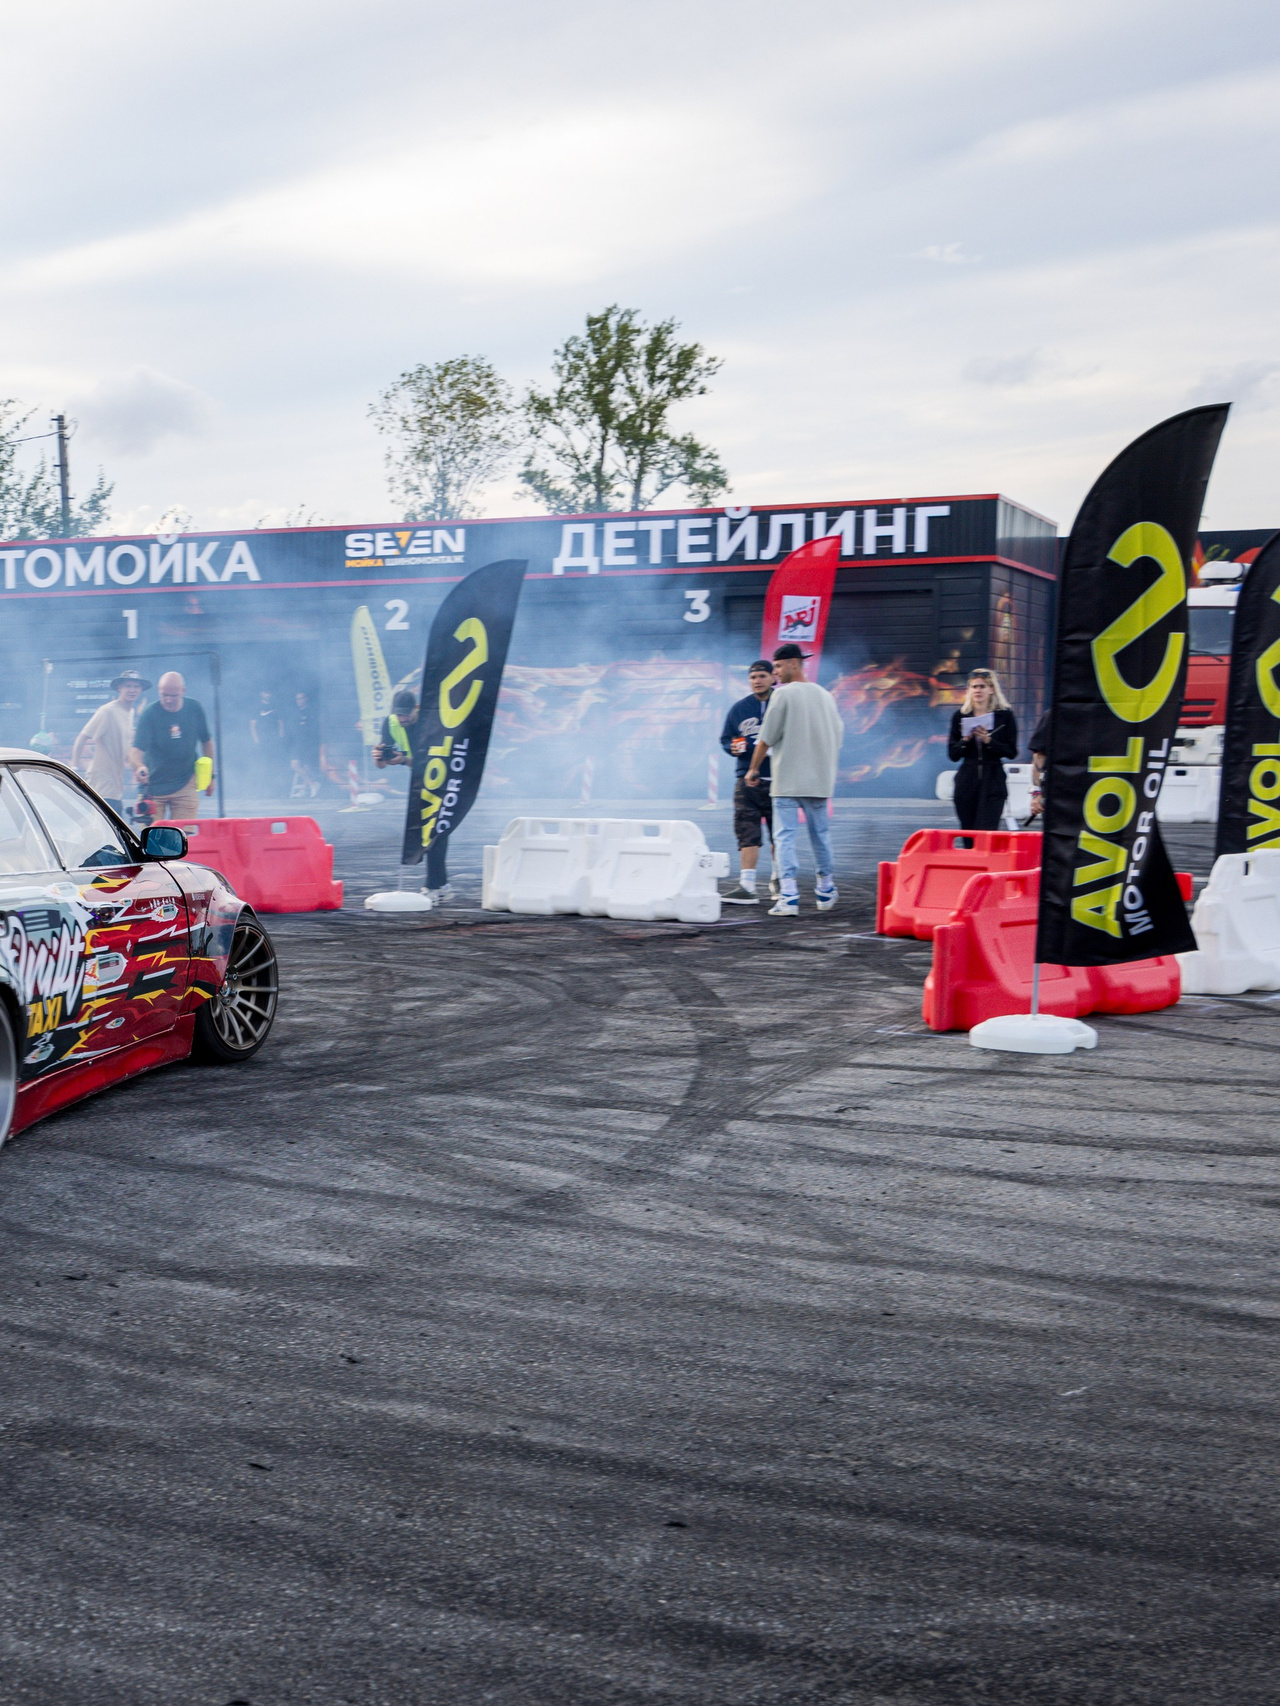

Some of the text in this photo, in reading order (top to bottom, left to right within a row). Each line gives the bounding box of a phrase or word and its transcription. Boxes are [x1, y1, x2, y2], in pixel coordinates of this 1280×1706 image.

[552, 505, 951, 576] ДЕТЕЙЛИНГ
[122, 610, 138, 639] 1
[383, 599, 410, 630] 2
[682, 590, 711, 623] 3
[436, 738, 469, 834] OTOR OIL
[1071, 737, 1145, 938] AVOL
[1123, 738, 1169, 936] MOTOR OIL
[26, 996, 63, 1038] TAXI
